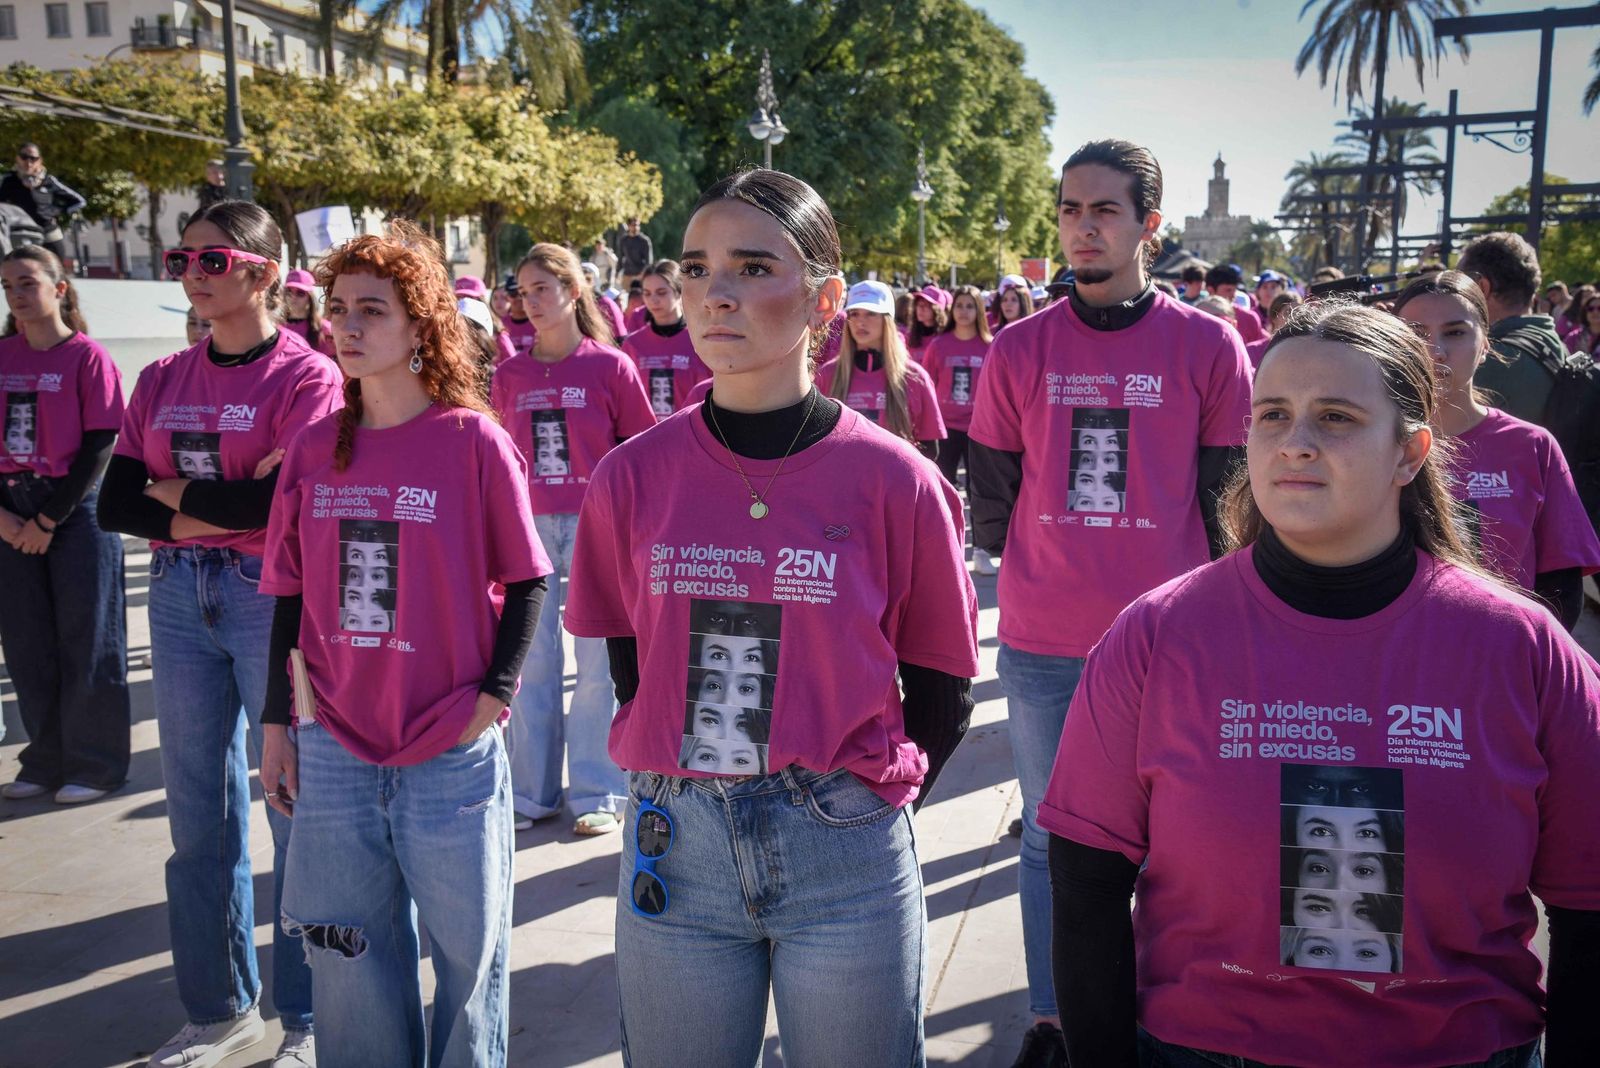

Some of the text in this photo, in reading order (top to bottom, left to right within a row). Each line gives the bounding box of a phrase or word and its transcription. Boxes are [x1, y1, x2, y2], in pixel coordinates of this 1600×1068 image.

[1046, 372, 1118, 386] Sin violencia,
[1124, 374, 1162, 392] 25N
[562, 387, 586, 399] 25N
[1063, 384, 1100, 396] miedo,
[220, 404, 256, 420] 25N
[1467, 470, 1508, 487] 25N
[314, 484, 390, 498] Sin violencia,
[396, 486, 437, 508] 25N
[314, 496, 370, 508] sin miedo,
[312, 507, 378, 518] sin excusas
[1136, 518, 1150, 528] 016
[650, 543, 766, 567] Sin violencia,
[650, 560, 736, 582] sin miedo,
[775, 548, 837, 580] 25N
[650, 578, 748, 598] sin excusas
[787, 578, 832, 588] Internacional
[772, 592, 831, 604] hacia las Mujeres
[805, 586, 837, 597] Violencia
[397, 640, 411, 650] 016
[1220, 698, 1372, 726] Sin violencia,
[1387, 704, 1462, 740] 25N
[1220, 719, 1338, 744] sin miedo,
[1219, 739, 1356, 762] sin excusas
[1388, 737, 1464, 750] Día Internacional
[1388, 746, 1471, 760] contra la Violencia
[1388, 754, 1464, 768] hacia las Mujeres
